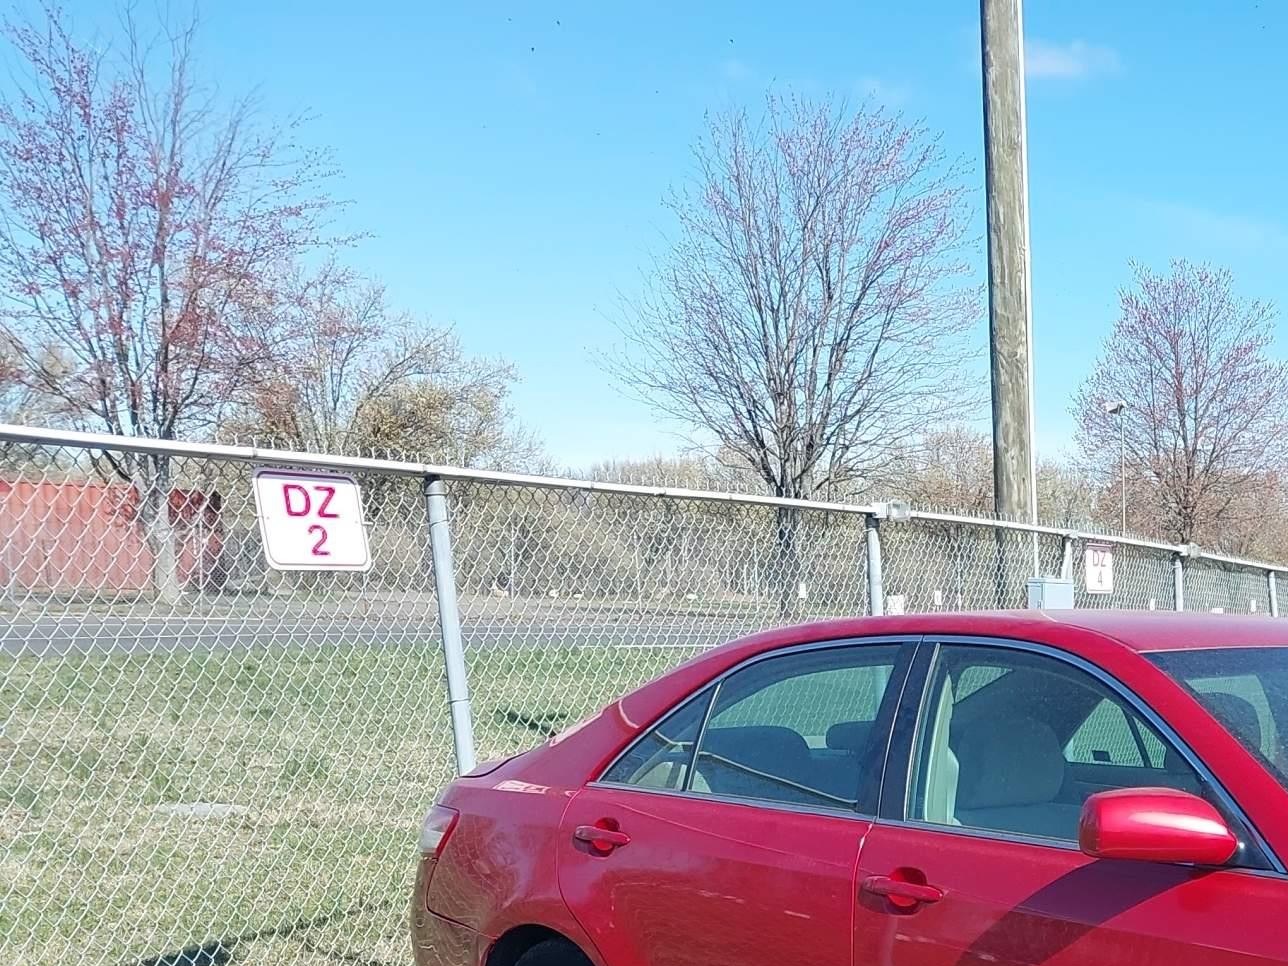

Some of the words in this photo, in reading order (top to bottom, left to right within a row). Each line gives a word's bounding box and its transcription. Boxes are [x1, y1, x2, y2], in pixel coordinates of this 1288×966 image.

[282, 484, 340, 518] DZ
[307, 524, 331, 556] 2
[1091, 550, 1107, 567] DZ
[1097, 569, 1104, 585] 4
